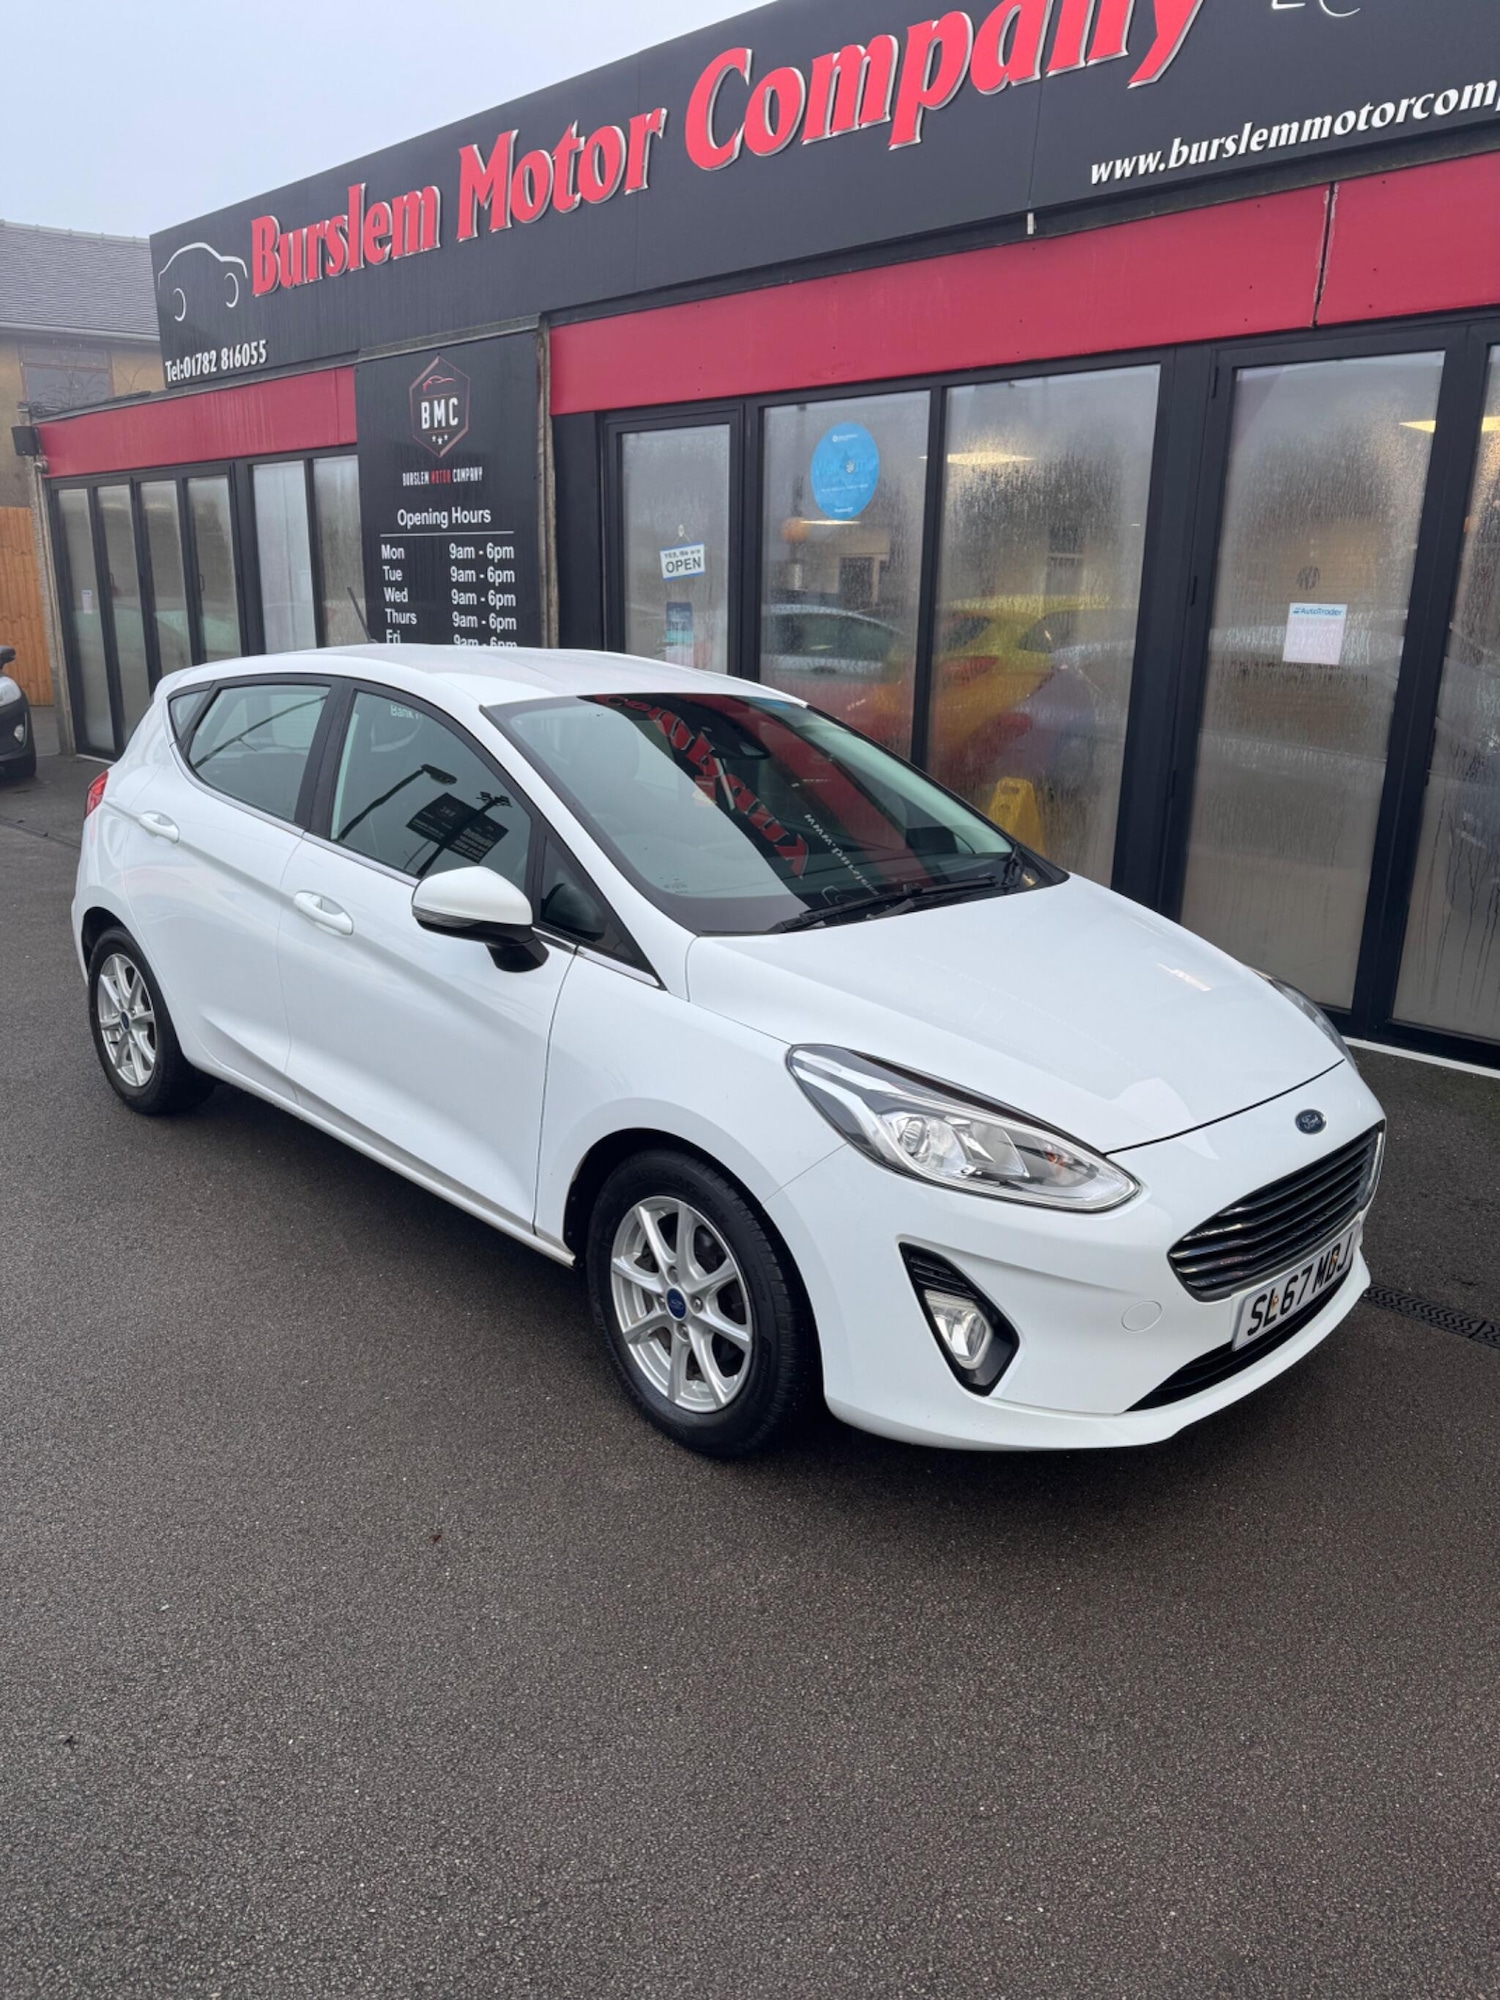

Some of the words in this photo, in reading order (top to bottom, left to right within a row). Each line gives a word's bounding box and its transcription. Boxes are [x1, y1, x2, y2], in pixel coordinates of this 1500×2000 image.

[1090, 79, 1500, 186] www.burslemmotorcom
[252, 182, 441, 298] Burslem
[456, 107, 668, 243] Motor
[164, 349, 217, 382] Tel:01782
[220, 339, 267, 371] 816055
[420, 396, 459, 430] BMC
[402, 471, 430, 487] BURSLEM
[452, 466, 483, 483] COMPANY
[397, 508, 449, 529] Opening
[451, 507, 491, 526] Hours
[381, 544, 405, 560] Mon
[449, 543, 475, 559] 9am
[486, 542, 514, 562] 6pm
[382, 565, 403, 581] Tue
[450, 566, 476, 582] 9am
[487, 566, 515, 586] 6pm
[665, 556, 702, 573] OPEN
[384, 587, 409, 603] Wed
[451, 588, 477, 605] 9am
[488, 589, 516, 609] 6pm
[385, 608, 417, 625] Thurs
[452, 611, 478, 628] 9am
[489, 612, 517, 633] 6pm
[386, 629, 401, 644] Fri
[1247, 1262, 1315, 1337] SL67
